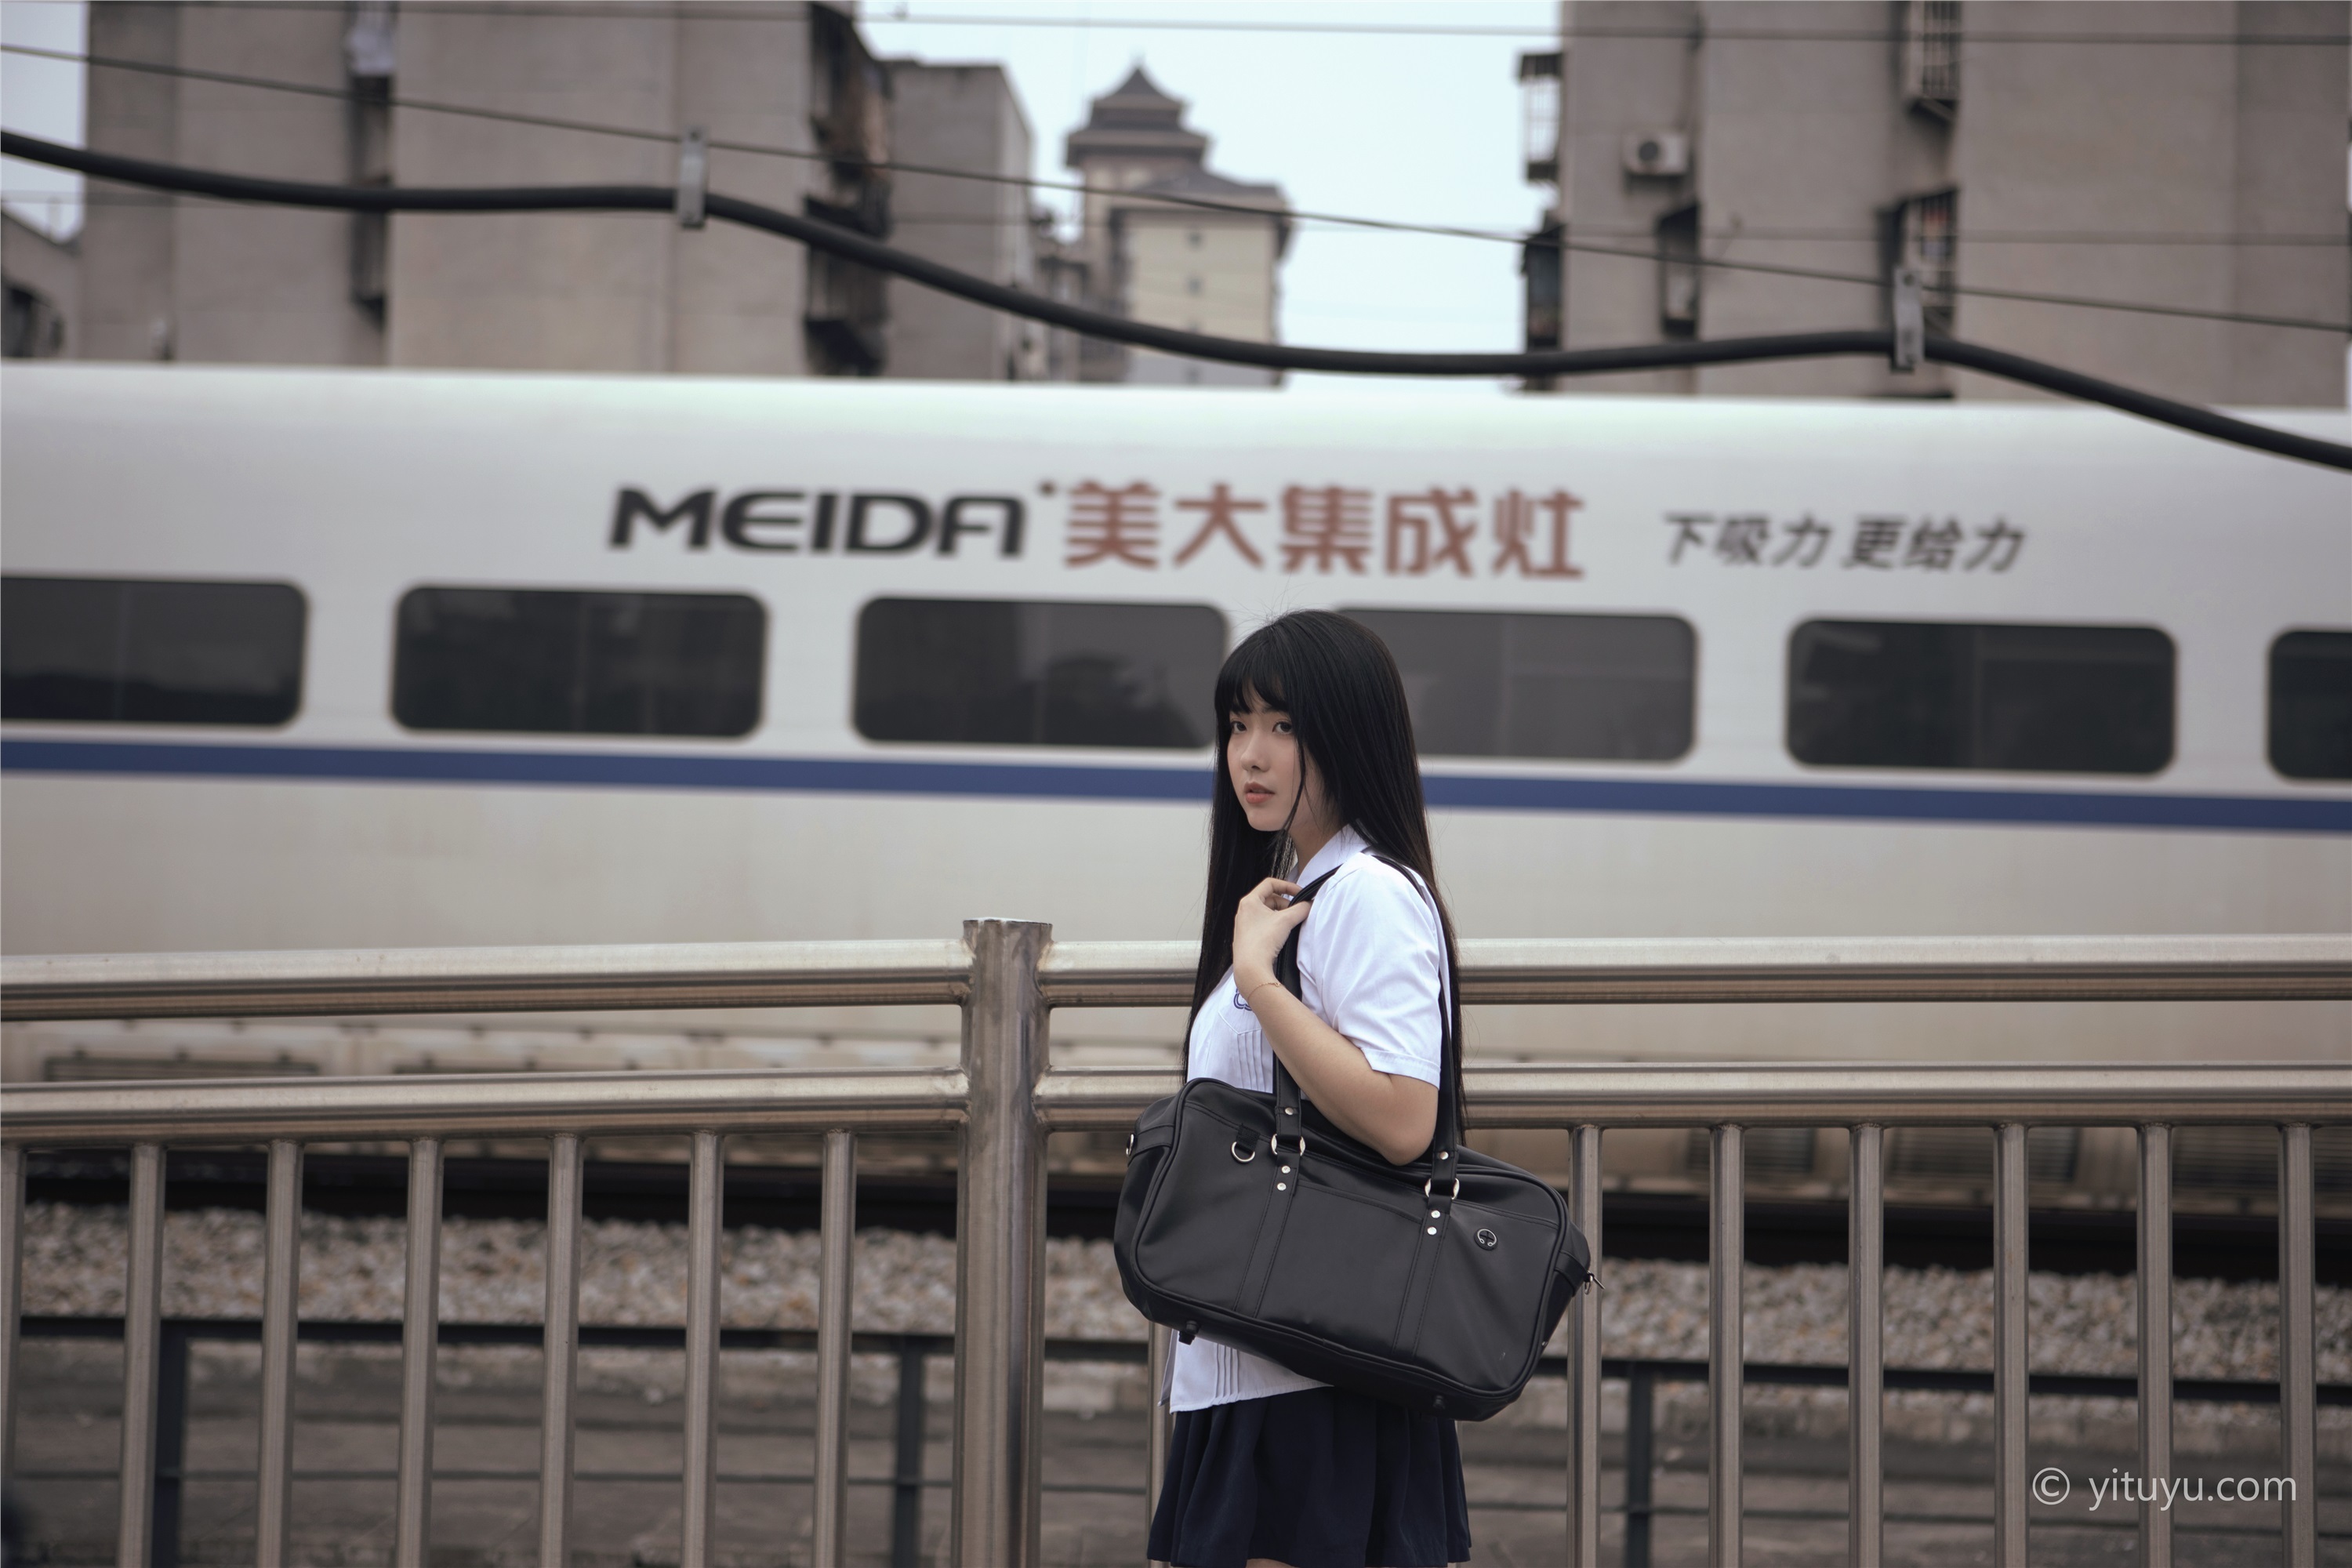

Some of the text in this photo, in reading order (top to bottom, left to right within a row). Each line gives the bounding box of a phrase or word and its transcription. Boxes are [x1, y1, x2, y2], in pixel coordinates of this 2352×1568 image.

[609, 481, 1584, 579] MEIDA 美大集成灶
